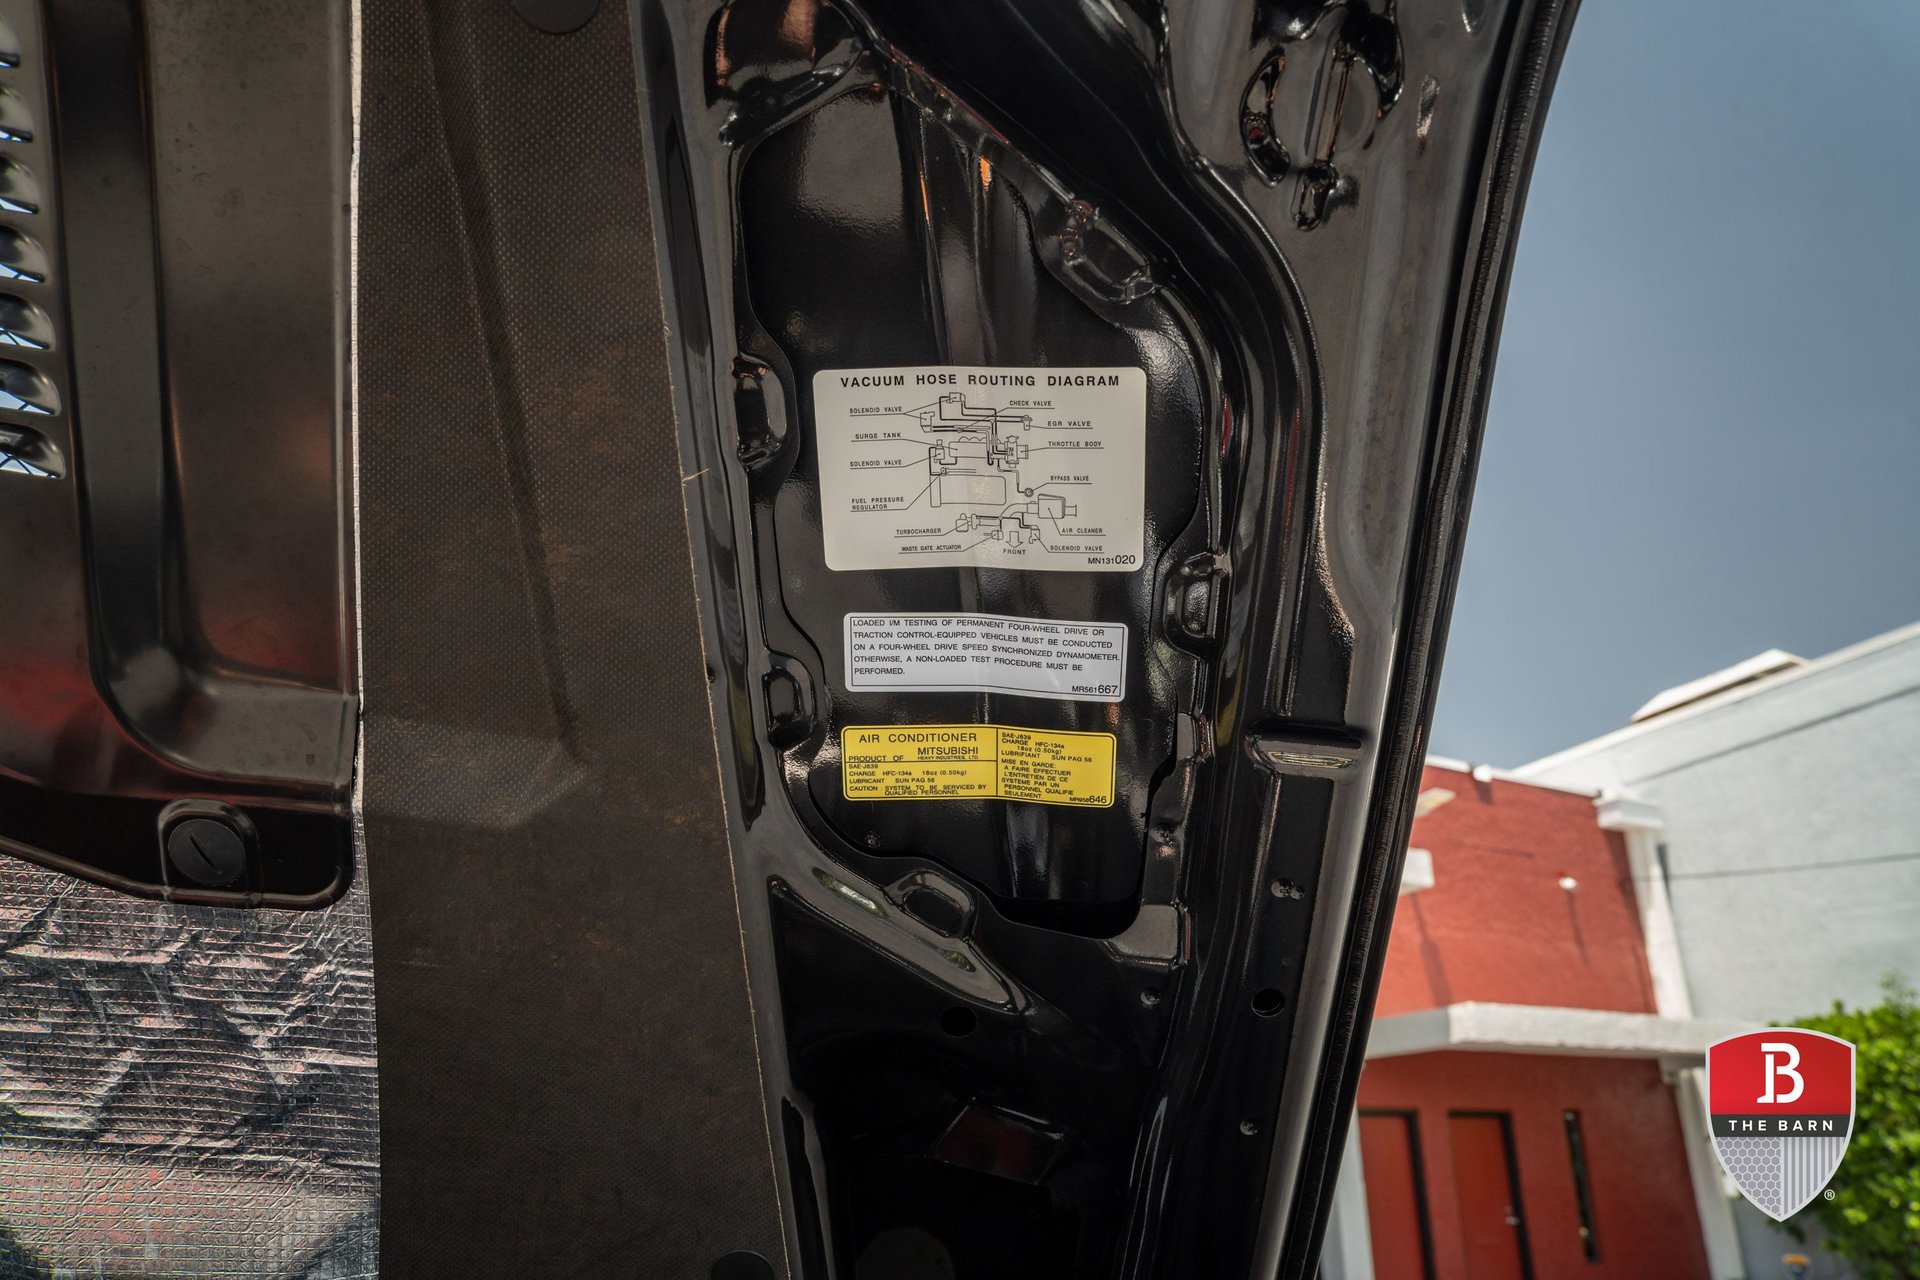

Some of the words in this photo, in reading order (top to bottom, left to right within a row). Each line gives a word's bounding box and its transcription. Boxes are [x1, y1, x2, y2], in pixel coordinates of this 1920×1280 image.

[840, 376, 905, 388] VACUUM
[916, 374, 957, 384] HOSE
[968, 375, 1035, 386] ROUTING
[1048, 376, 1119, 386] DIAGRAM
[1088, 555, 1136, 564] MN131020
[956, 620, 1004, 628] PERMANENT
[1008, 623, 1060, 634] FOUR-WHEEL
[981, 633, 1018, 642] VEHICLES
[1062, 640, 1112, 648] CONDUCTED
[992, 646, 1052, 657] SYNCHRONIZED
[1056, 652, 1120, 661] DYNAMOMETER.
[994, 658, 1042, 668] PROCEDURE
[1072, 685, 1118, 694] MR561667
[859, 734, 880, 743] AIR
[888, 733, 977, 742] CONDITIONER
[1002, 732, 1031, 740] SAE-J639
[917, 747, 978, 755] MITSUBISHI
[1033, 768, 1071, 776] EFFECTUER
[1004, 784, 1042, 793] PERSONNEL
[1004, 790, 1044, 799] SEULEMENT.
